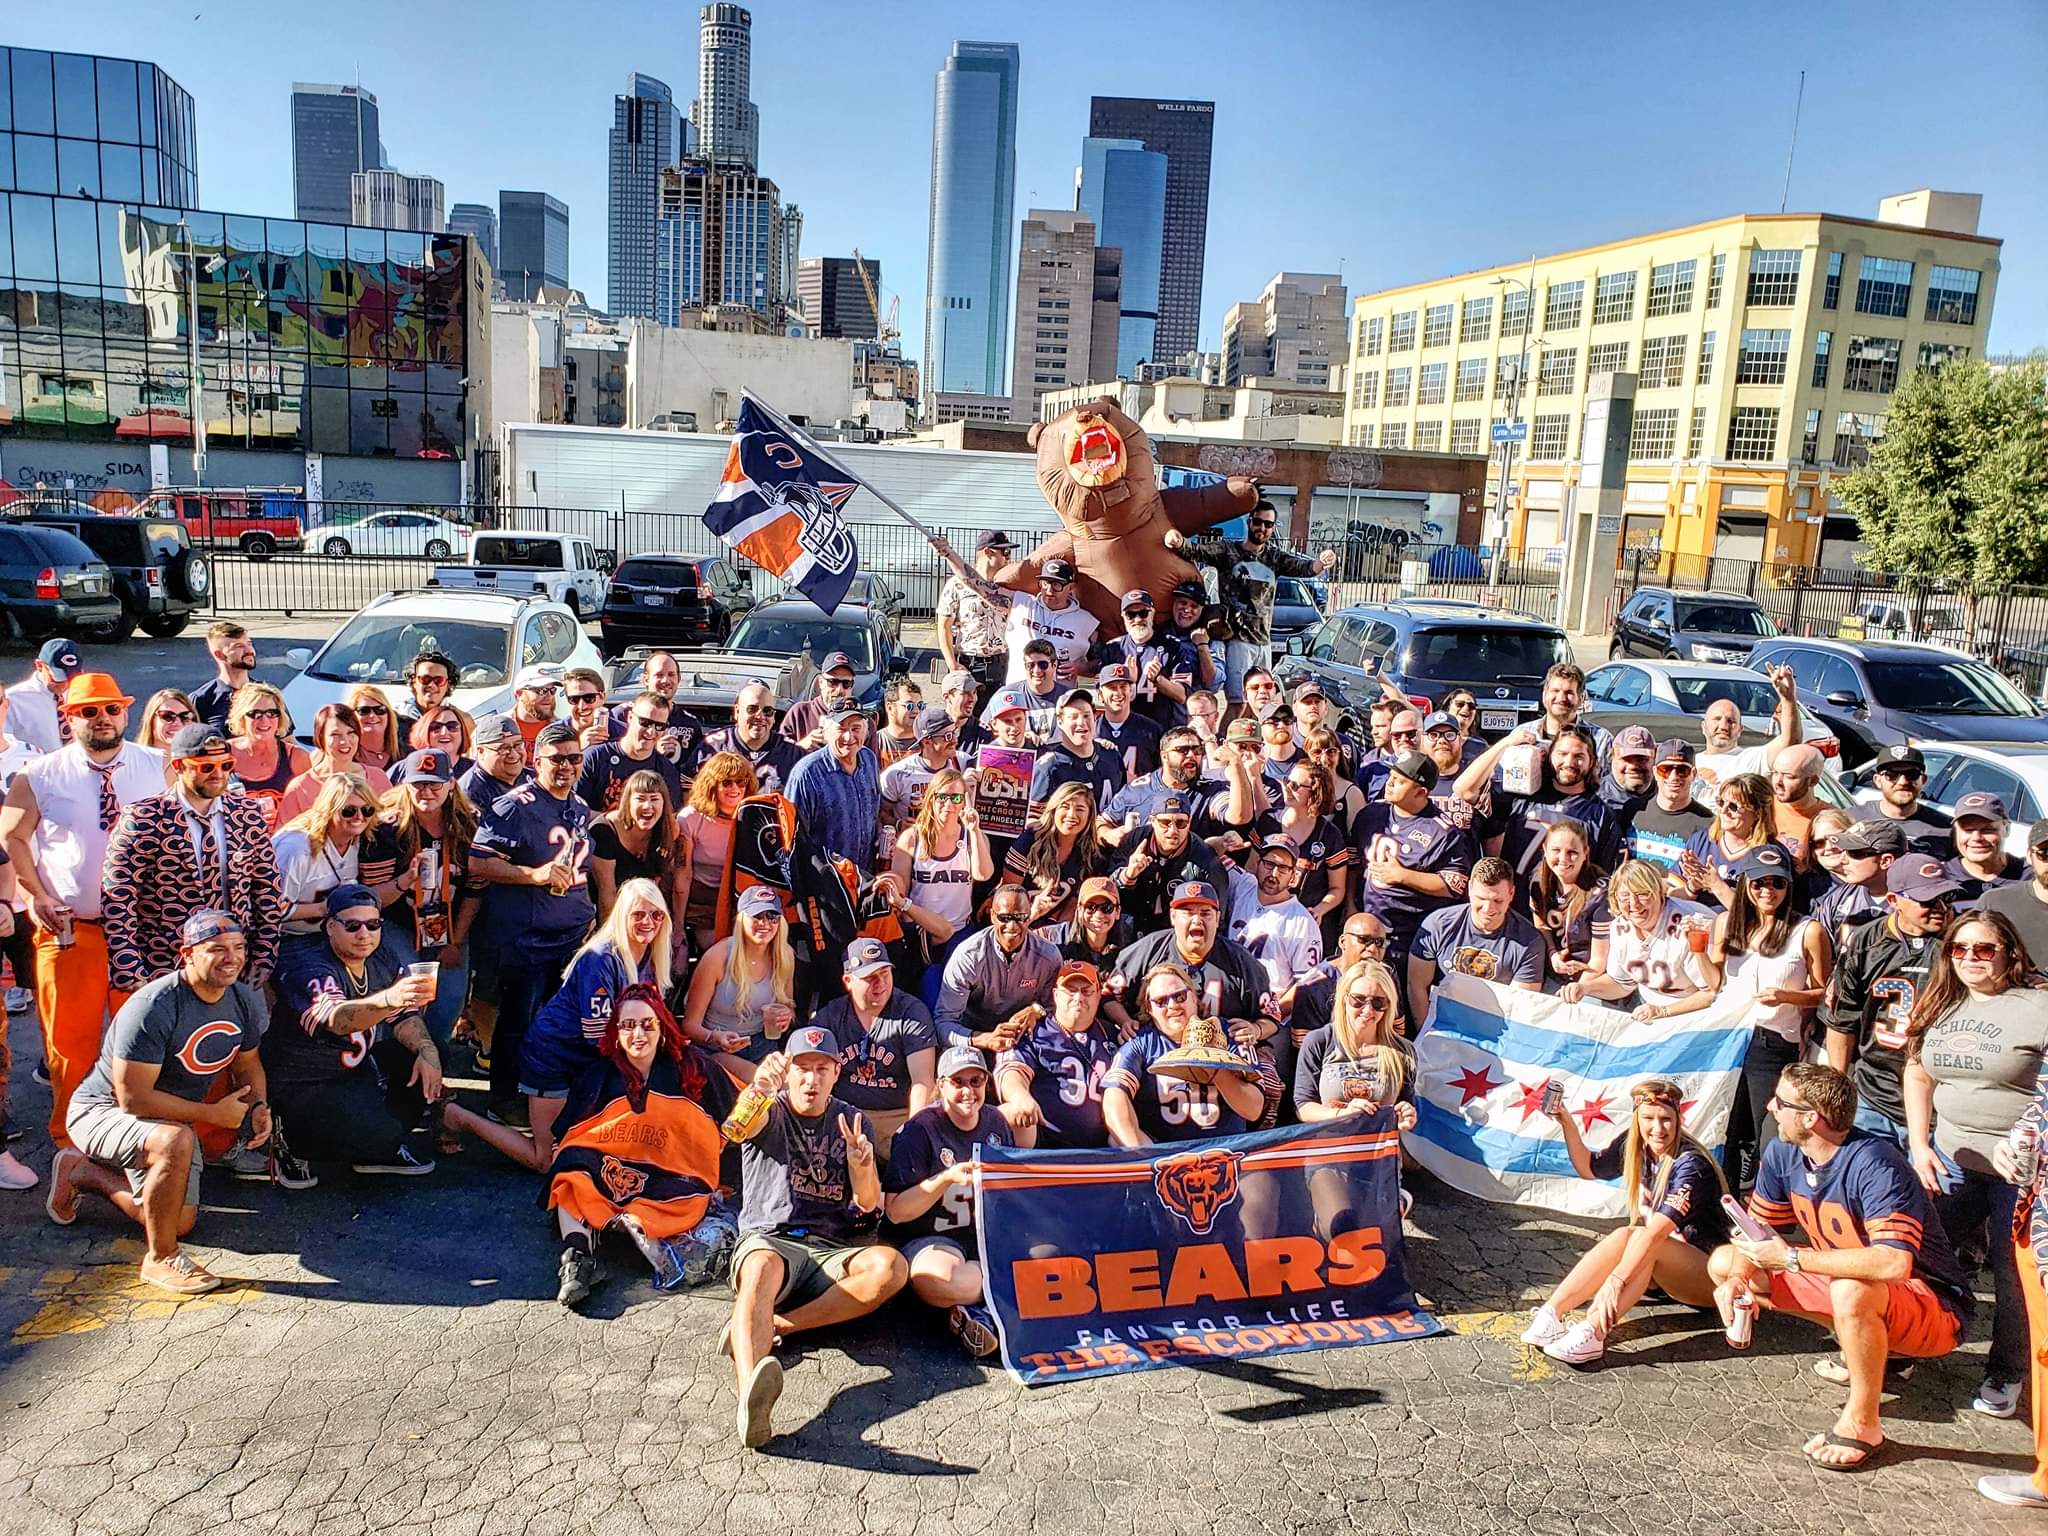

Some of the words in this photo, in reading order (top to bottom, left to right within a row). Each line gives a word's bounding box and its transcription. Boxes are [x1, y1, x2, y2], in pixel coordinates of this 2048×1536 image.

[1157, 103, 1185, 111] WELLS
[1187, 104, 1213, 113] FARGO
[106, 462, 144, 476] SIDA
[1022, 617, 1076, 640] BEARS
[60, 654, 78, 667] C
[976, 804, 1014, 815] CHICAGO
[990, 815, 1025, 826] ANGELES
[912, 869, 971, 885] EAR
[808, 895, 826, 951] BEARS
[590, 996, 613, 1018] 54
[1940, 1018, 2003, 1040] CHICAGO
[174, 1020, 242, 1075] C
[1238, 1044, 1259, 1065] 50
[1979, 1042, 2002, 1054] 1920
[1933, 1053, 1984, 1071] BEARS
[597, 1122, 669, 1150] BEARS
[1012, 1226, 1388, 1321] BEARS
[1076, 1324, 1150, 1347] FAN
[1172, 1313, 1242, 1336] FOR
[1272, 1299, 1352, 1326] LIFE
[1020, 1342, 1140, 1376] THE
[1137, 1310, 1427, 1362] ESCONDITE
